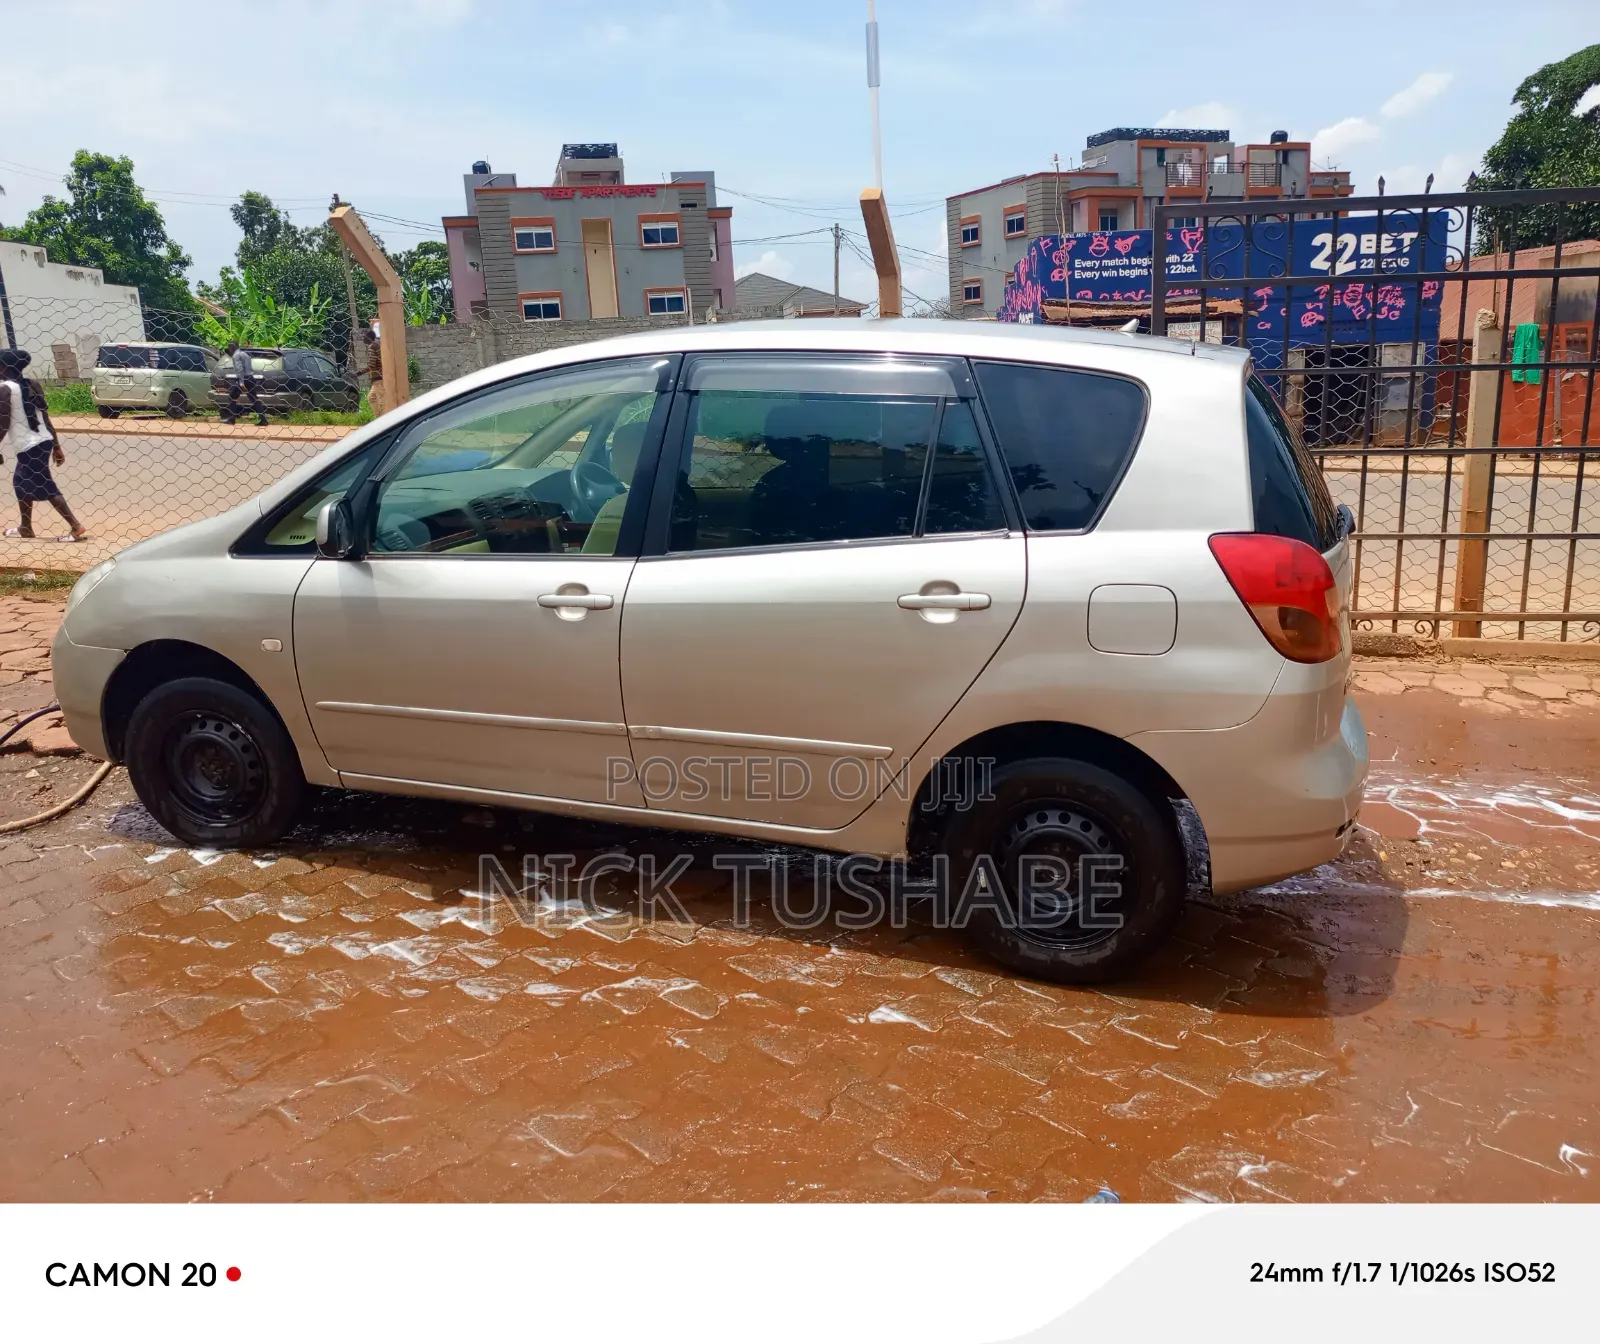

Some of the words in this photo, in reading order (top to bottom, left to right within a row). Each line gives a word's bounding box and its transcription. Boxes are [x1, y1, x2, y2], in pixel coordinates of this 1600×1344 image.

[581, 186, 657, 198] APARTMENTS
[1075, 259, 1100, 270] Every
[1102, 257, 1129, 267] match
[1182, 253, 1194, 263] 22
[1075, 270, 1100, 280] Every
[1102, 269, 1118, 277] win
[1119, 268, 1148, 278] begins
[1170, 265, 1198, 274] 22bet.
